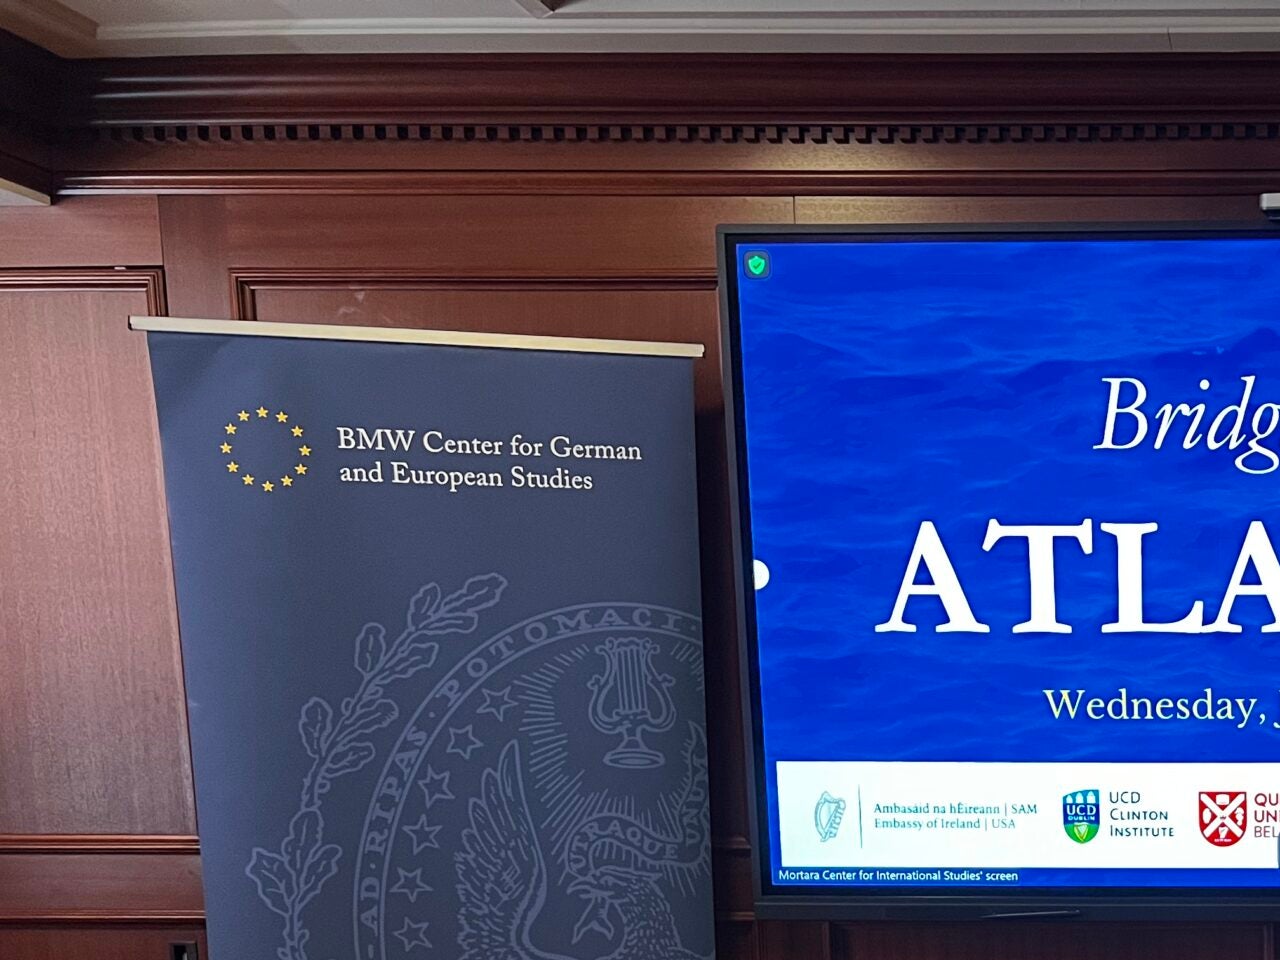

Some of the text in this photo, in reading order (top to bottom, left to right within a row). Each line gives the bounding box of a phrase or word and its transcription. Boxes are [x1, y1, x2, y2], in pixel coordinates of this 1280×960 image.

[337, 427, 641, 459] BMW Center for German
[340, 462, 592, 492] and European Studies
[1043, 688, 1265, 728] Wednesday,
[1109, 791, 1141, 804] UCD
[874, 802, 930, 814] Ambasáid
[933, 805, 946, 814] na
[1011, 804, 1037, 814] SAM
[1066, 804, 1097, 816] UCD
[1109, 807, 1168, 821] CLINTON
[874, 817, 1016, 829] Embassy of Ireland USA
[1110, 824, 1174, 837] INSTITUTE
[778, 869, 1019, 881] Mortara Center for International Studies' screen
